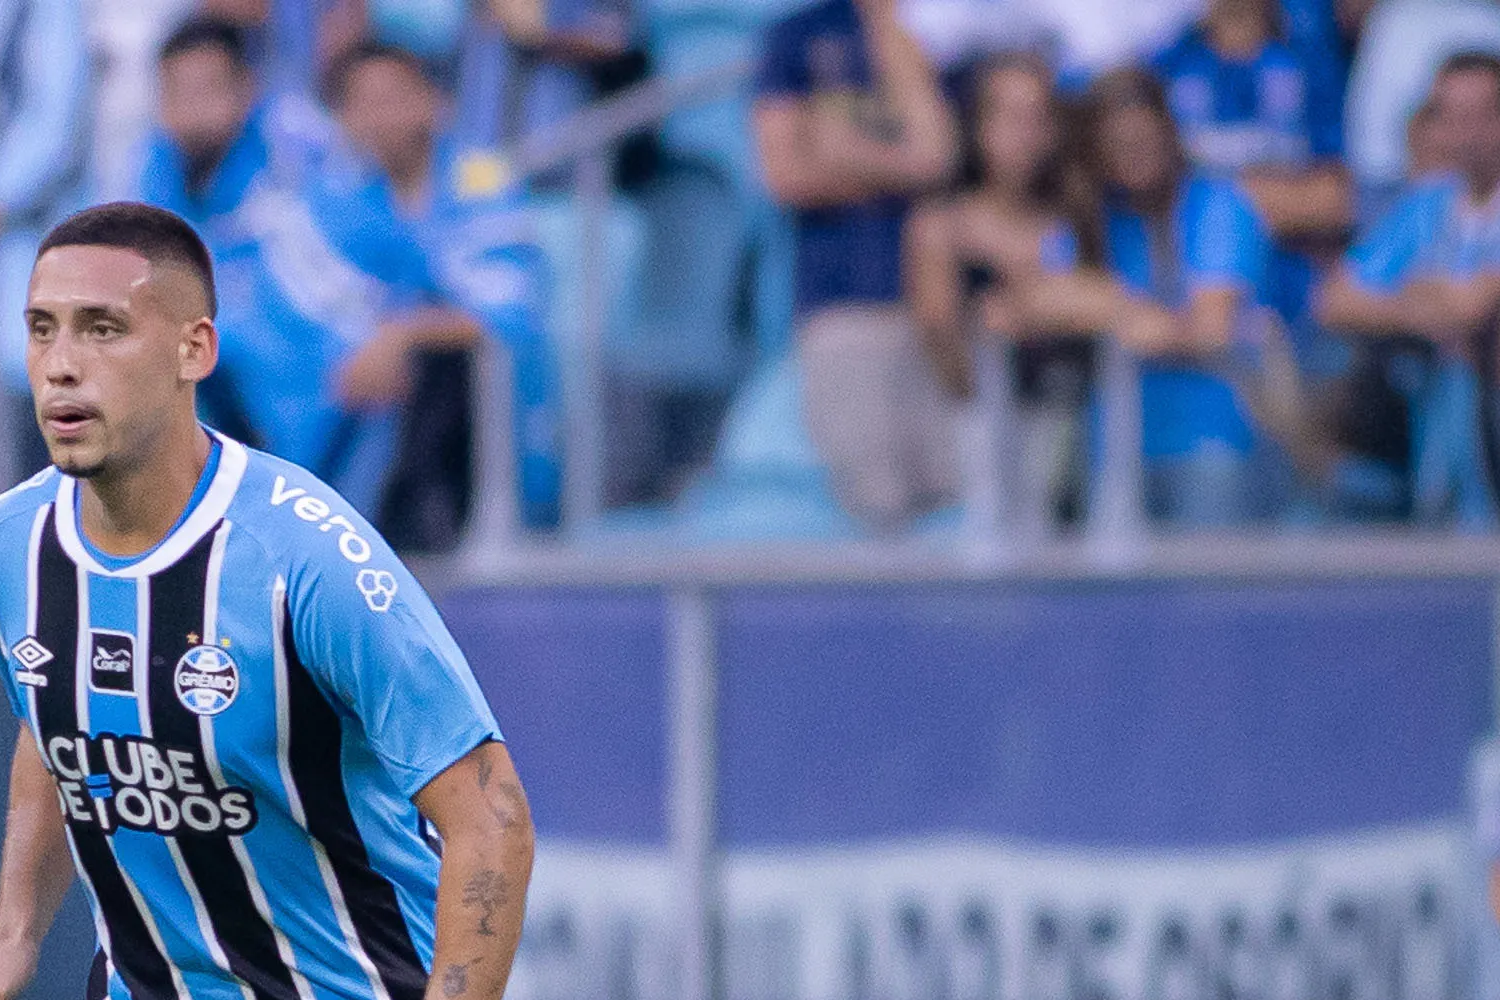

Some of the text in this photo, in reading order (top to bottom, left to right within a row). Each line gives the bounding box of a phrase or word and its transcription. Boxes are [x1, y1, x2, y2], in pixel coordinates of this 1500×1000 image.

[270, 475, 371, 563] vero
[49, 736, 204, 794] CLUBE
[56, 781, 252, 832] E TODOS
